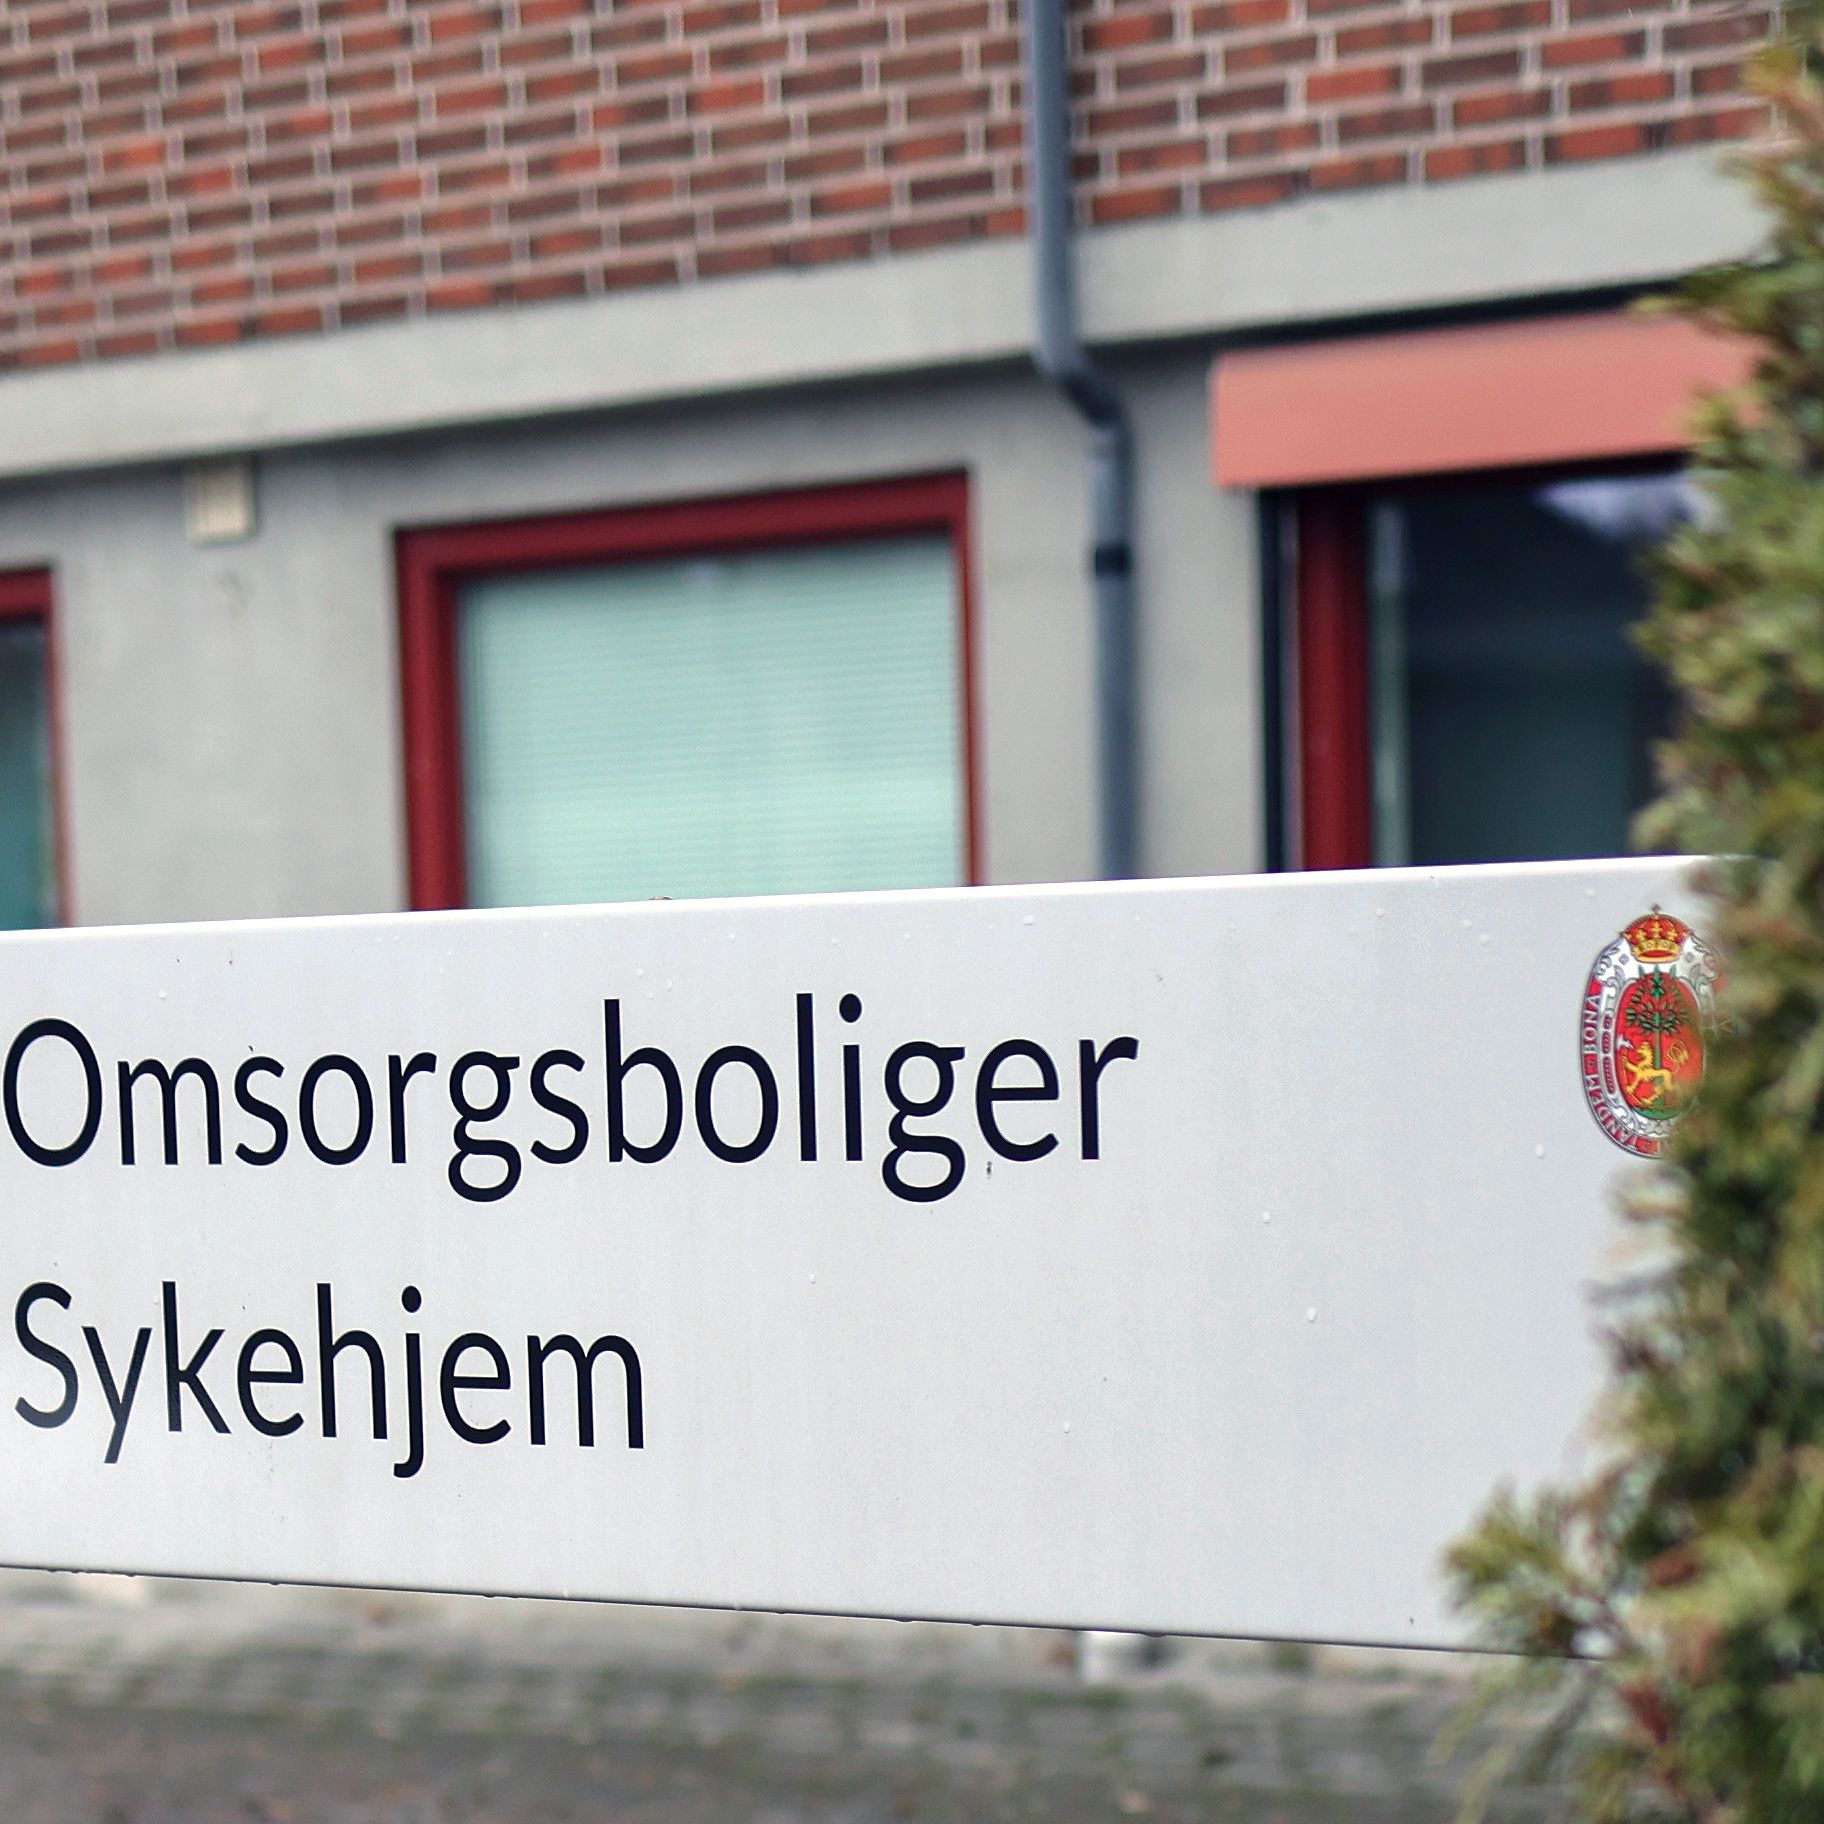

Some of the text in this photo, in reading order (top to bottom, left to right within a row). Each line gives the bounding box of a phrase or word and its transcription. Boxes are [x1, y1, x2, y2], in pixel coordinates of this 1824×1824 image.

[2, 992, 1139, 1203] Omsorgsboliger
[1583, 994, 1601, 1055] BONA
[14, 1280, 644, 1479] Sykehjem
